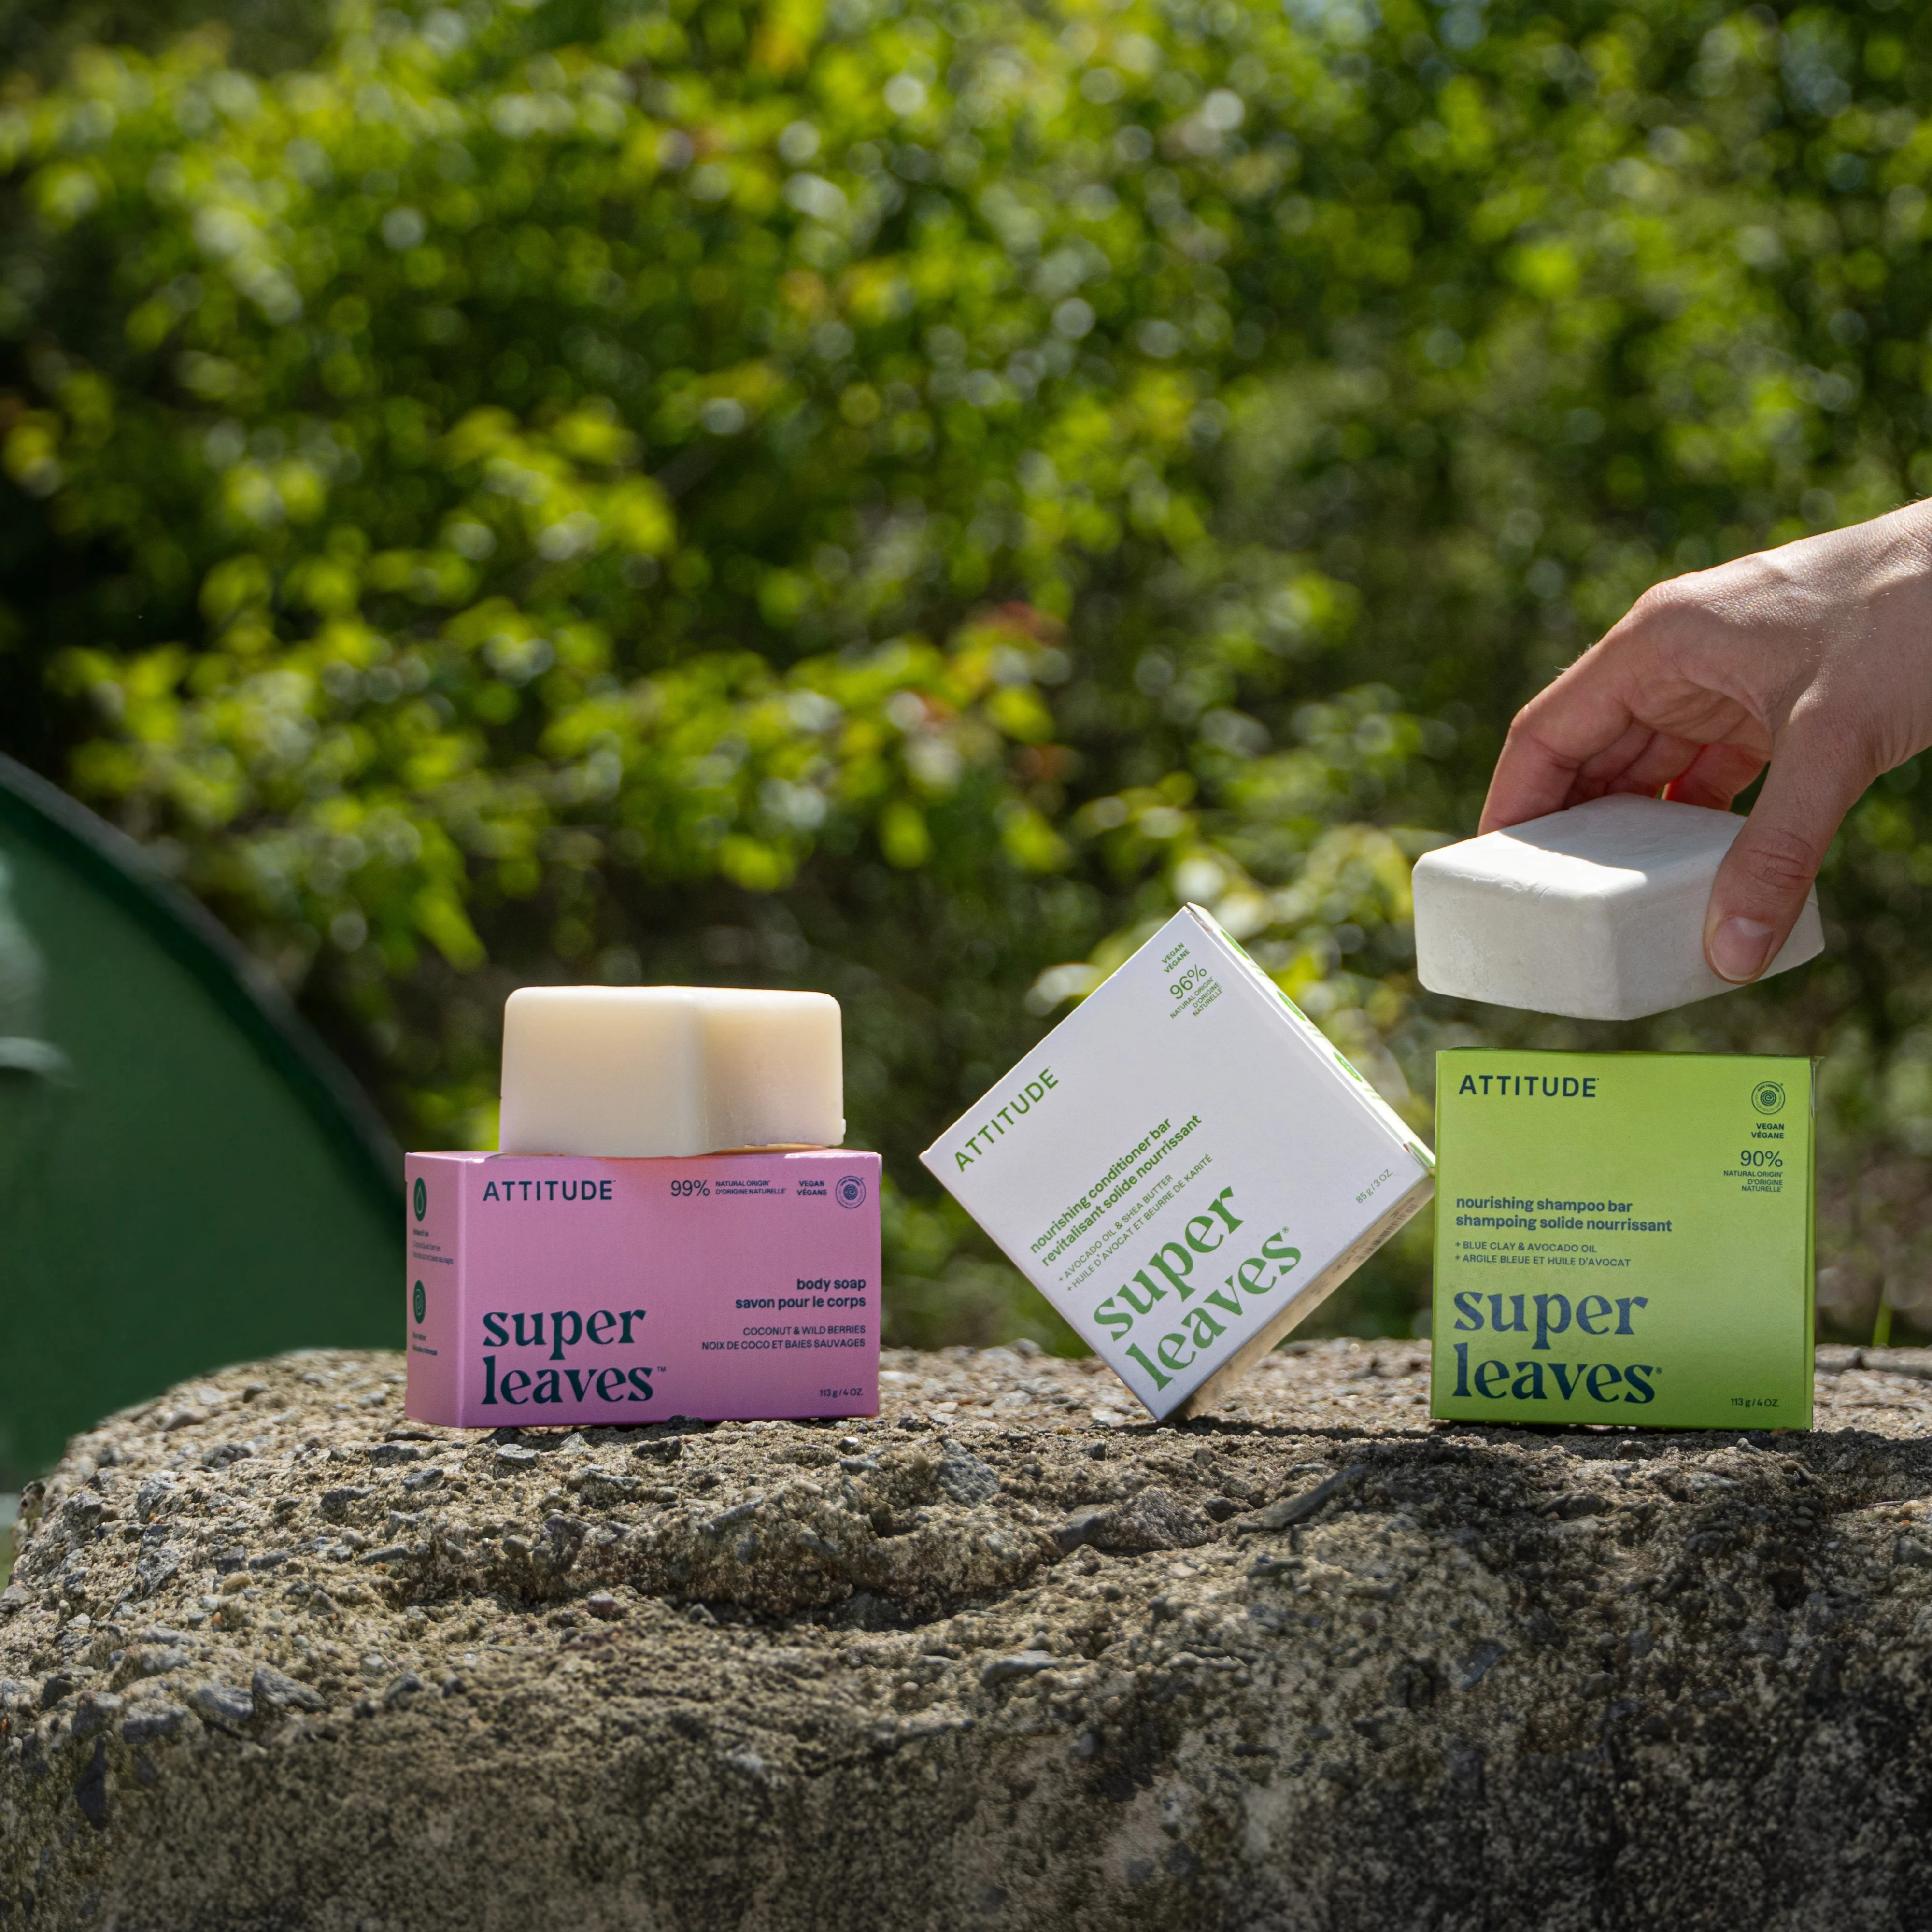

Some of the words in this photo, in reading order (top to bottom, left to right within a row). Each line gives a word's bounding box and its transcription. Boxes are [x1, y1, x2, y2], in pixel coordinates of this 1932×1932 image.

[1161, 942, 1185, 964] VEGAN
[1164, 949, 1190, 973] VÉGANE
[1170, 964, 1207, 1000] 96%
[1170, 995, 1196, 1019] NATURAL
[1740, 1150, 1783, 1167] 90%
[671, 1180, 710, 1196] 99%
[1030, 1196, 1091, 1253] nourishing
[1088, 1137, 1151, 1199] conditioner
[1149, 1118, 1171, 1140] bar
[1042, 1205, 1105, 1266] revitalisant
[1103, 1175, 1137, 1209] solide
[1136, 1115, 1202, 1178] nourrissant
[1456, 1196, 1534, 1212] nourishing
[1537, 1199, 1605, 1213] shampoo
[1608, 1201, 1633, 1212] bar
[1064, 1240, 1102, 1279] AVOCADO
[1102, 1230, 1117, 1242] OIL
[1115, 1222, 1123, 1230] &
[1122, 1202, 1144, 1223] SHEA
[1142, 1174, 1173, 1204] BUTTER
[1072, 1264, 1095, 1288] HUILE
[1133, 1218, 1144, 1230] ET
[1143, 1191, 1174, 1221] BEURRE
[1173, 1180, 1186, 1193] DE
[1184, 1153, 1213, 1182] KARITÉ
[1456, 1215, 1536, 1230] shampoing
[1540, 1217, 1583, 1229] solide
[1587, 1218, 1672, 1232] nourrissant
[1527, 1243, 1578, 1252] AVOCADO
[1093, 1185, 1244, 1341] super
[1463, 1254, 1497, 1263] ARGILE
[1500, 1255, 1530, 1264] BLEUE
[797, 1278, 831, 1292] body
[834, 1279, 866, 1291] soap
[736, 1299, 774, 1308] savon
[778, 1297, 810, 1310] pour
[813, 1296, 824, 1307] le
[827, 1297, 866, 1308] corps
[743, 1327, 792, 1335] COCONUT
[794, 1326, 800, 1335] &
[828, 1325, 866, 1334] BERRIES
[1454, 1291, 1648, 1350] super
[483, 1309, 646, 1360] super
[702, 1341, 725, 1350] NOIX
[773, 1340, 783, 1349] ET
[785, 1339, 812, 1348] BAIES
[814, 1338, 865, 1347] SAUVAGES
